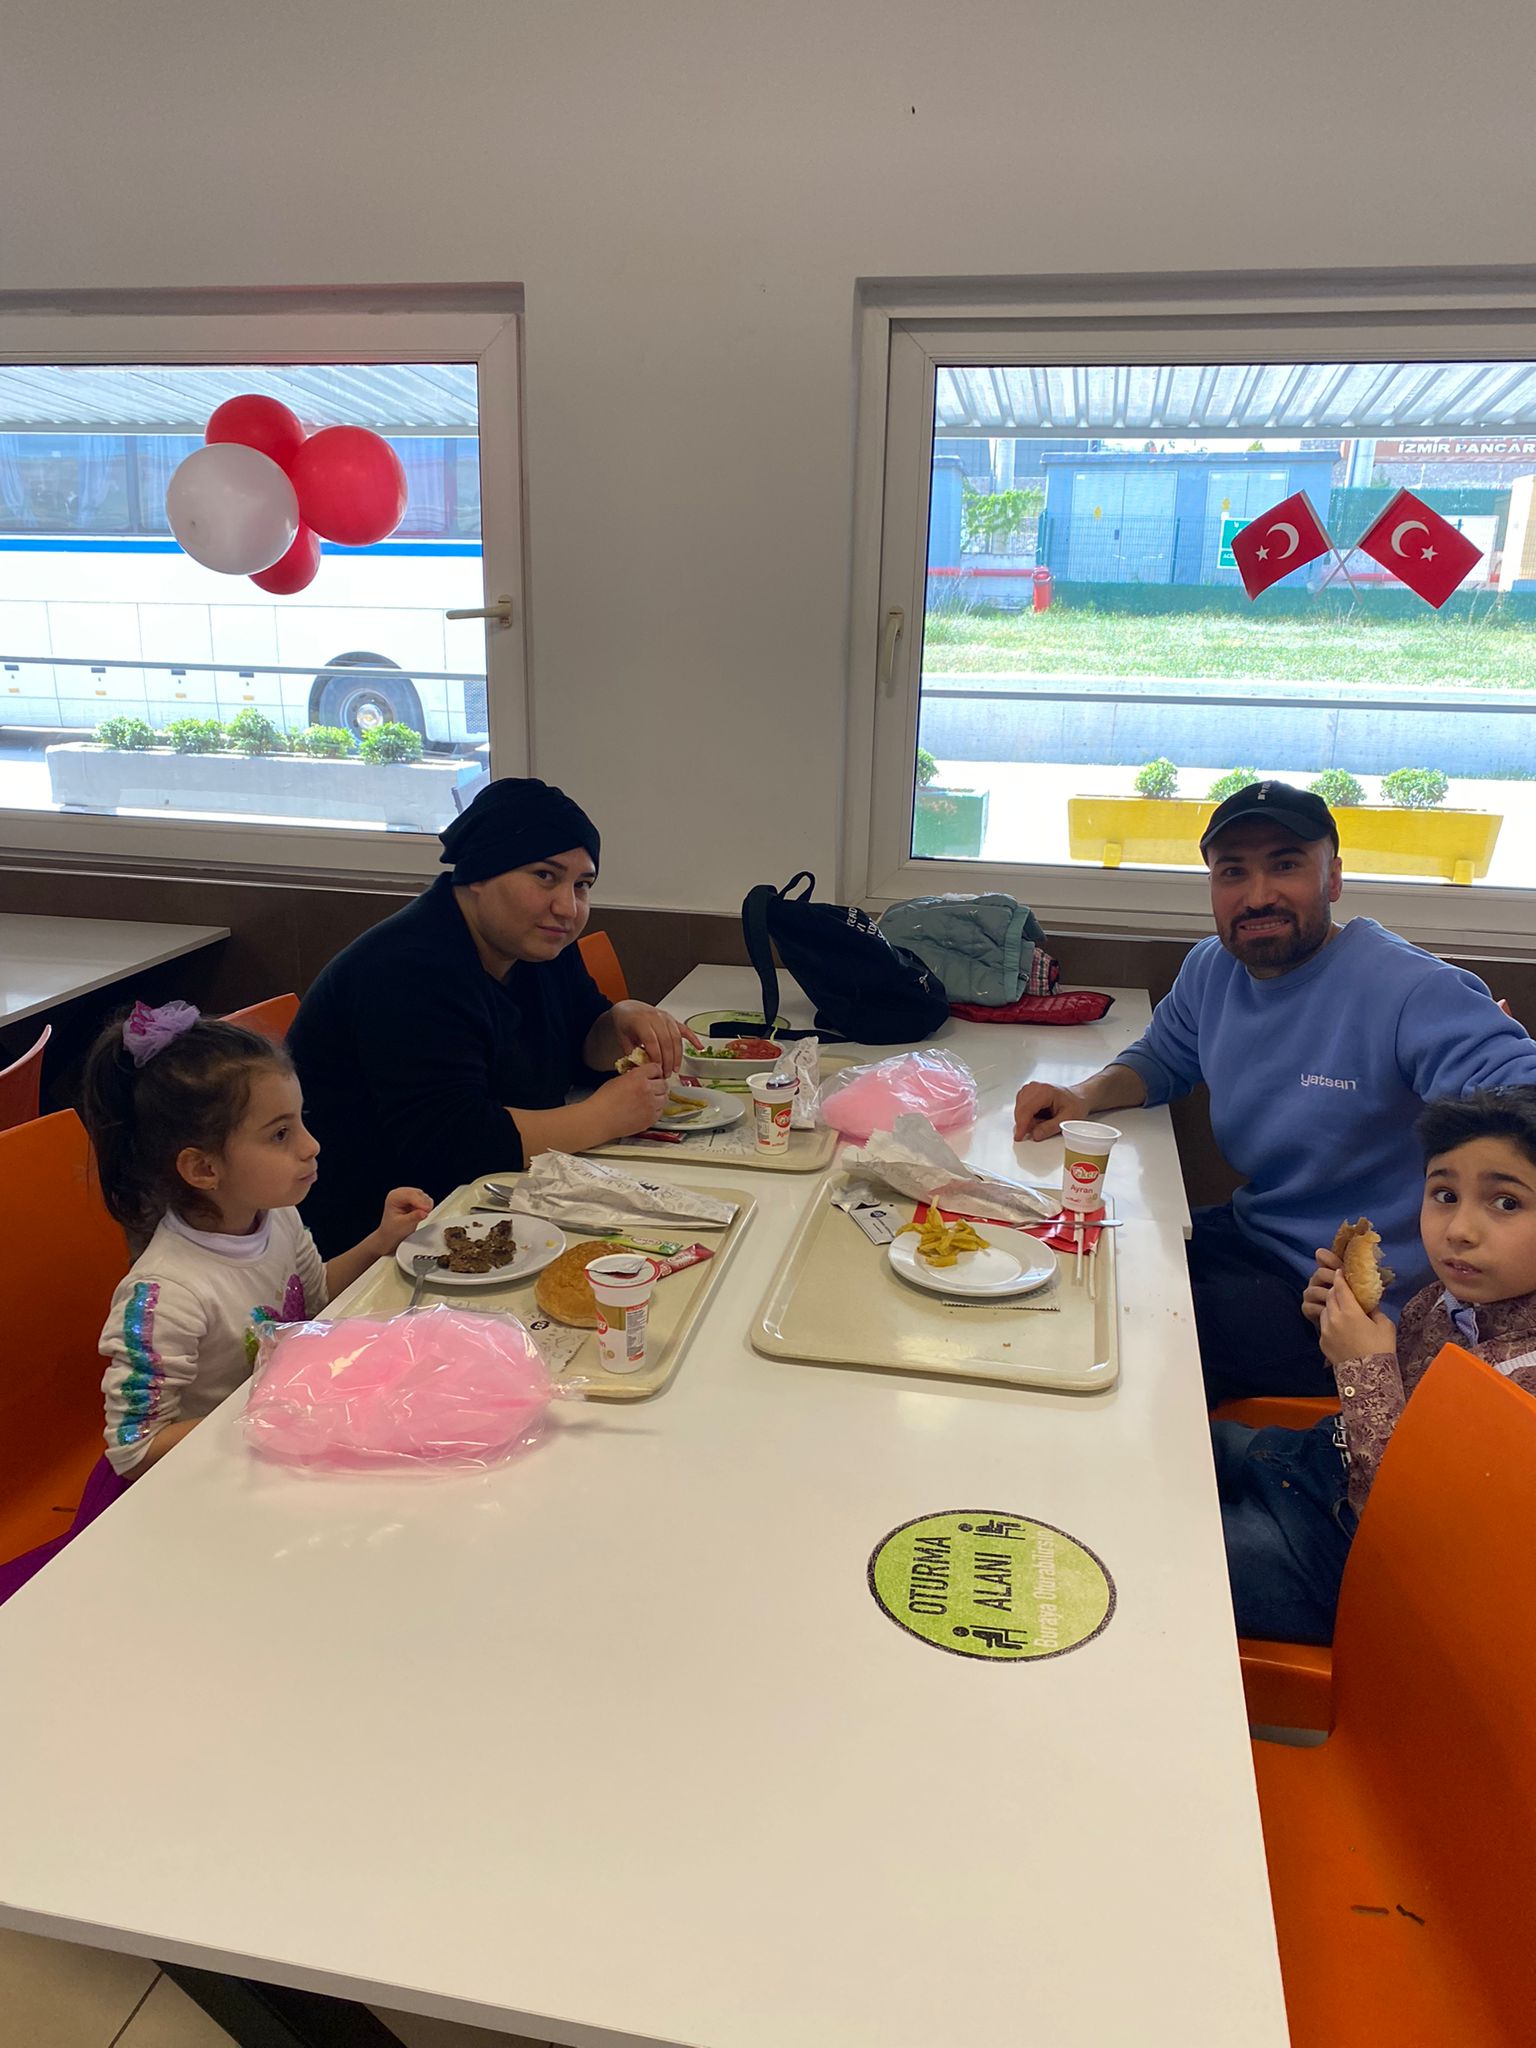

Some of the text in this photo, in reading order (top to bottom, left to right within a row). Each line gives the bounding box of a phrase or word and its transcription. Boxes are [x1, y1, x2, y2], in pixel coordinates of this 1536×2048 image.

[1398, 440, 1536, 454] İZMİR PANCAR
[1300, 1073, 1357, 1090] yatsan
[1070, 1184, 1094, 1193] Ayran
[908, 1536, 952, 1615] OTURMA
[973, 1551, 1012, 1613] ALANI
[1032, 1602, 1063, 1649] Buraya
